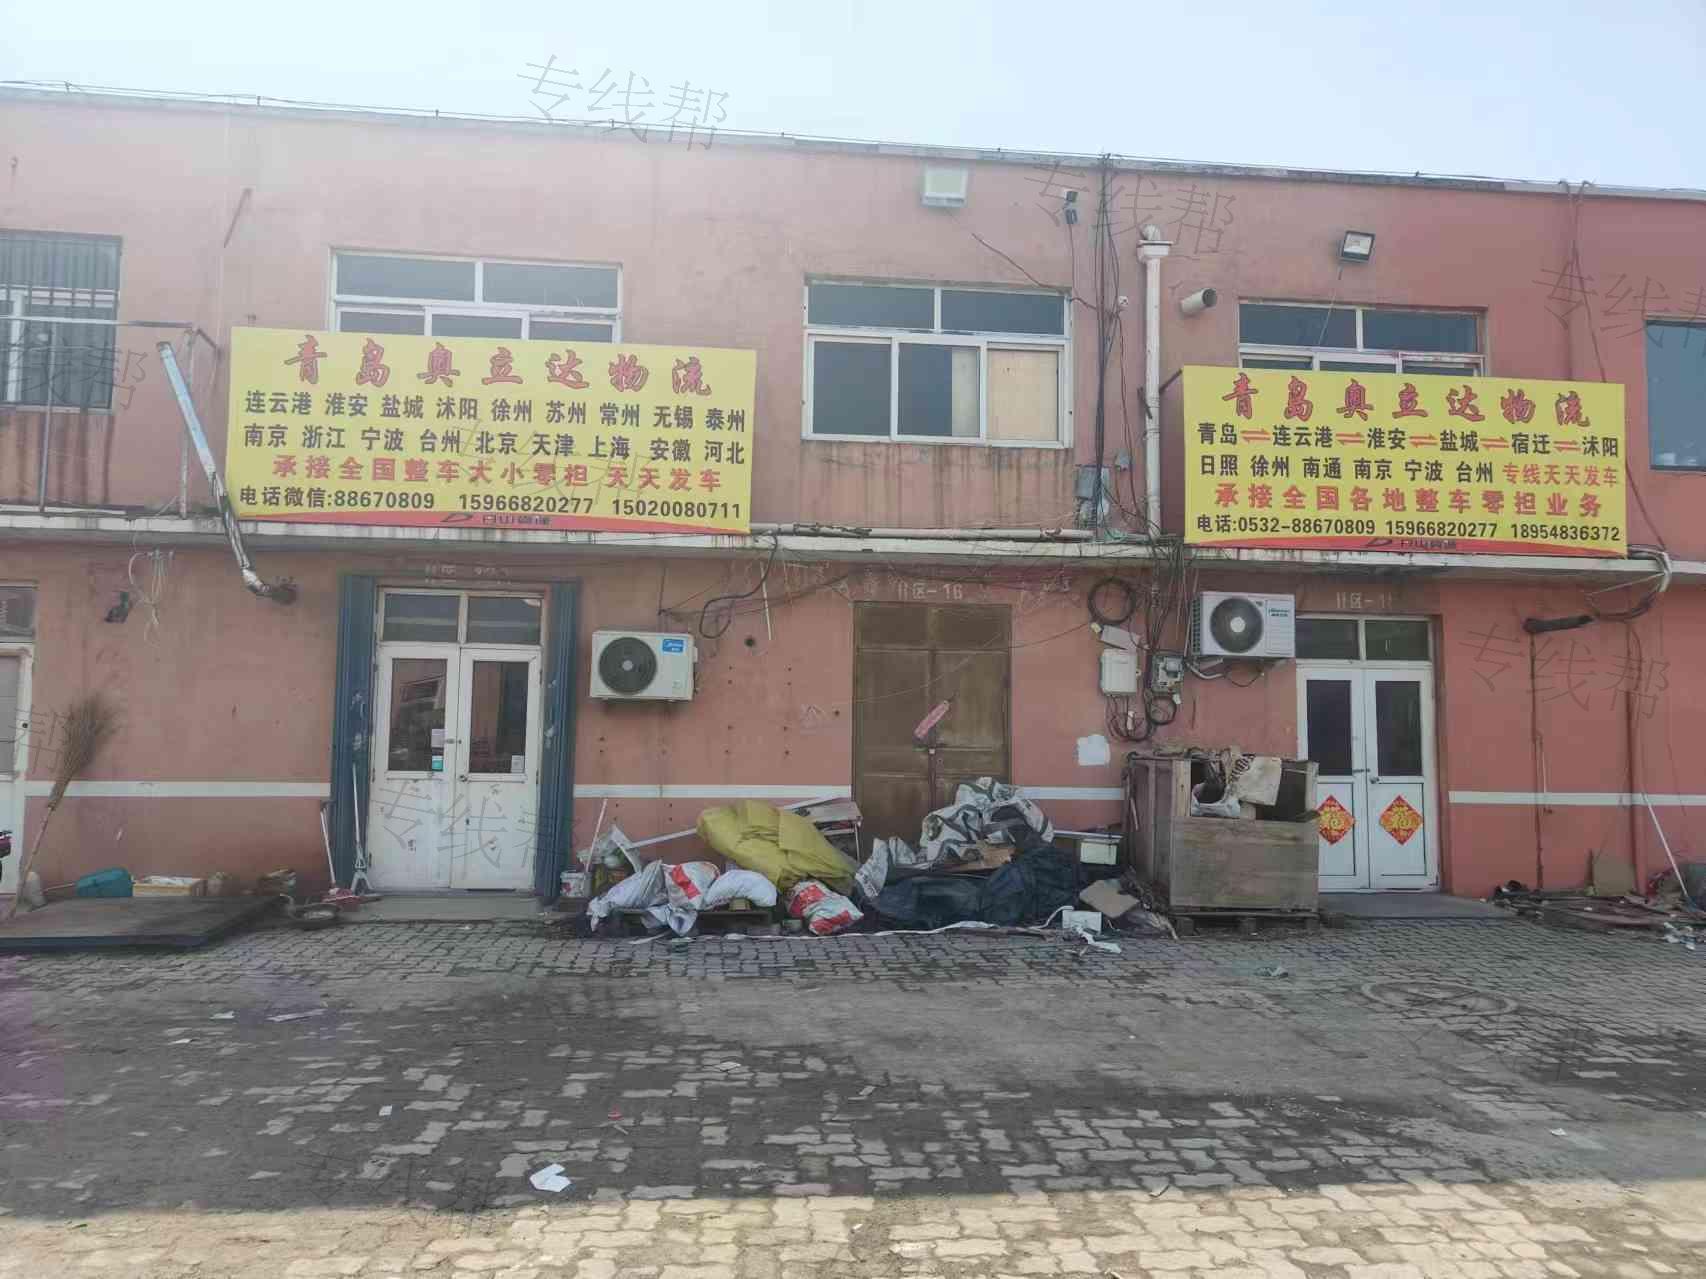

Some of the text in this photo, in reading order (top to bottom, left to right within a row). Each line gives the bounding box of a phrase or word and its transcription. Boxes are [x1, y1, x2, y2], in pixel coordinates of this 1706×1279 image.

[284, 334, 712, 396] 青岛奥立达物流
[245, 390, 745, 433] 连云港 淮安 盐城 沭阳 徐州 苏州 常州 无锡 泰州
[1221, 371, 1591, 427] 青岛奥立达物流
[243, 423, 745, 465] 南京 浙江 宁波 台州 北京 天津 上海 安徽 河北
[1197, 422, 1619, 457] 青岛 连云港 淮安 盐城 宿迁 沭阳
[1201, 454, 1619, 488] 日照 徐州 南通 南京 宁波 台州 专线天天发车
[459, 494, 594, 514] 15966820277
[611, 500, 741, 519] 15020080711
[1215, 482, 1602, 518] 承接全国各地整车零担业务
[1385, 520, 1498, 538] 15966820277
[1510, 523, 1620, 541] 18954836372
